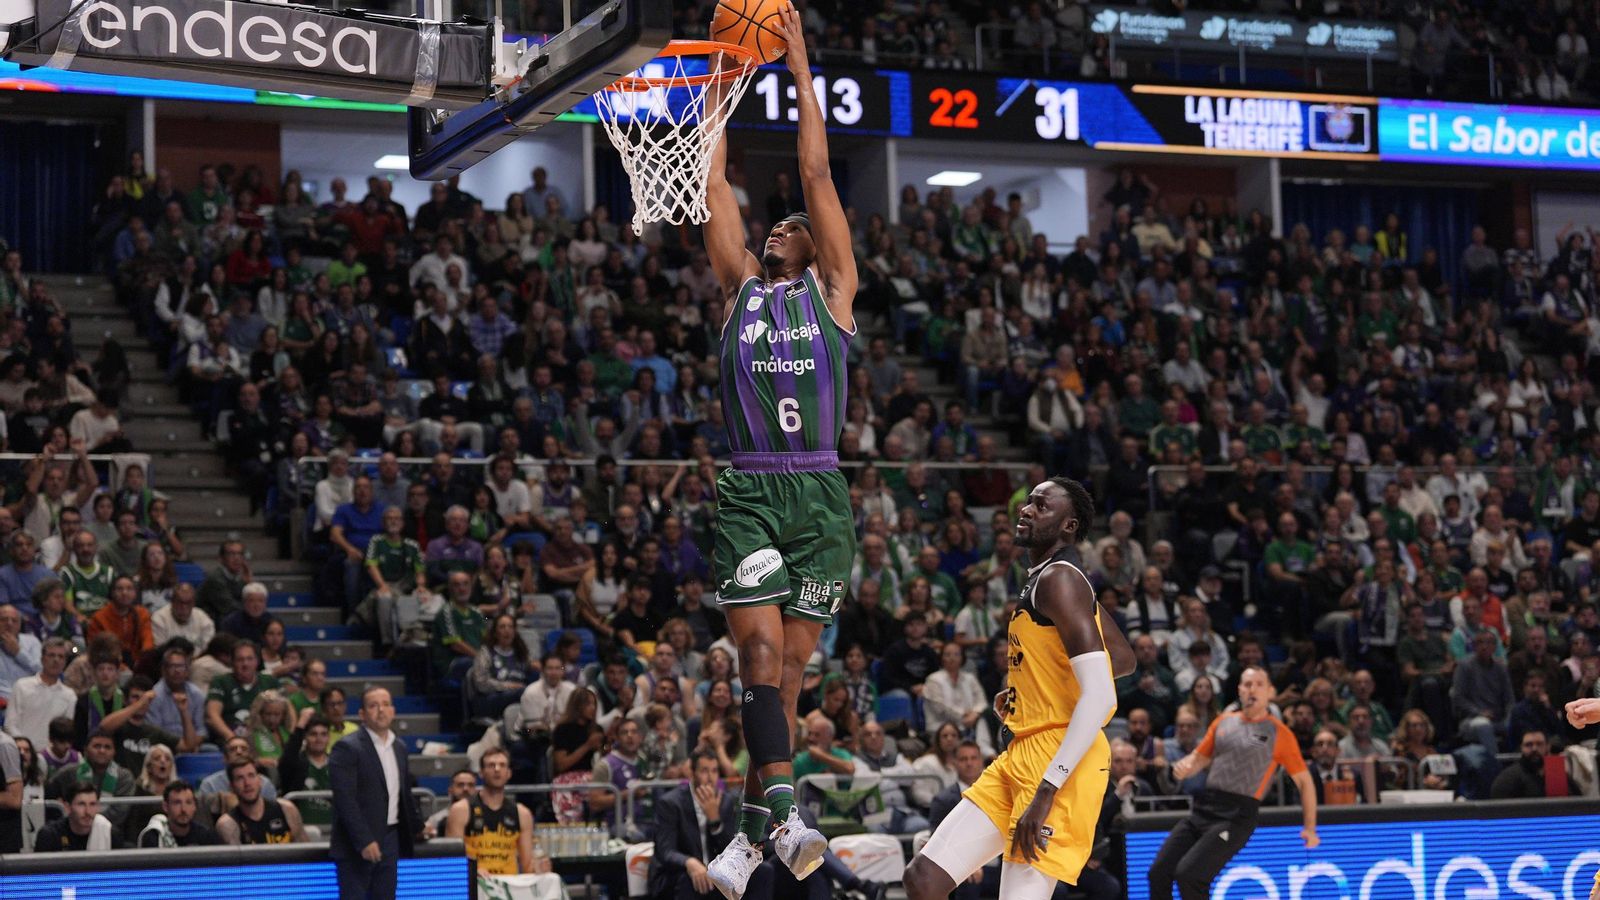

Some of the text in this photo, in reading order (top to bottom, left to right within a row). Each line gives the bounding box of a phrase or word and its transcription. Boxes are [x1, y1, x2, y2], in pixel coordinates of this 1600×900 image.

[80, 0, 377, 75] endesa
[756, 73, 863, 124] 1:13
[929, 88, 979, 128] 22
[1035, 87, 1079, 140] 31
[1185, 95, 1303, 126] LA LAGUNA
[1200, 122, 1304, 151] TENERIFE
[1408, 112, 1438, 151] El
[1449, 116, 1557, 156] Sabor
[767, 322, 821, 344] Unicaja
[751, 355, 816, 375] málaga
[778, 397, 802, 432] 6
